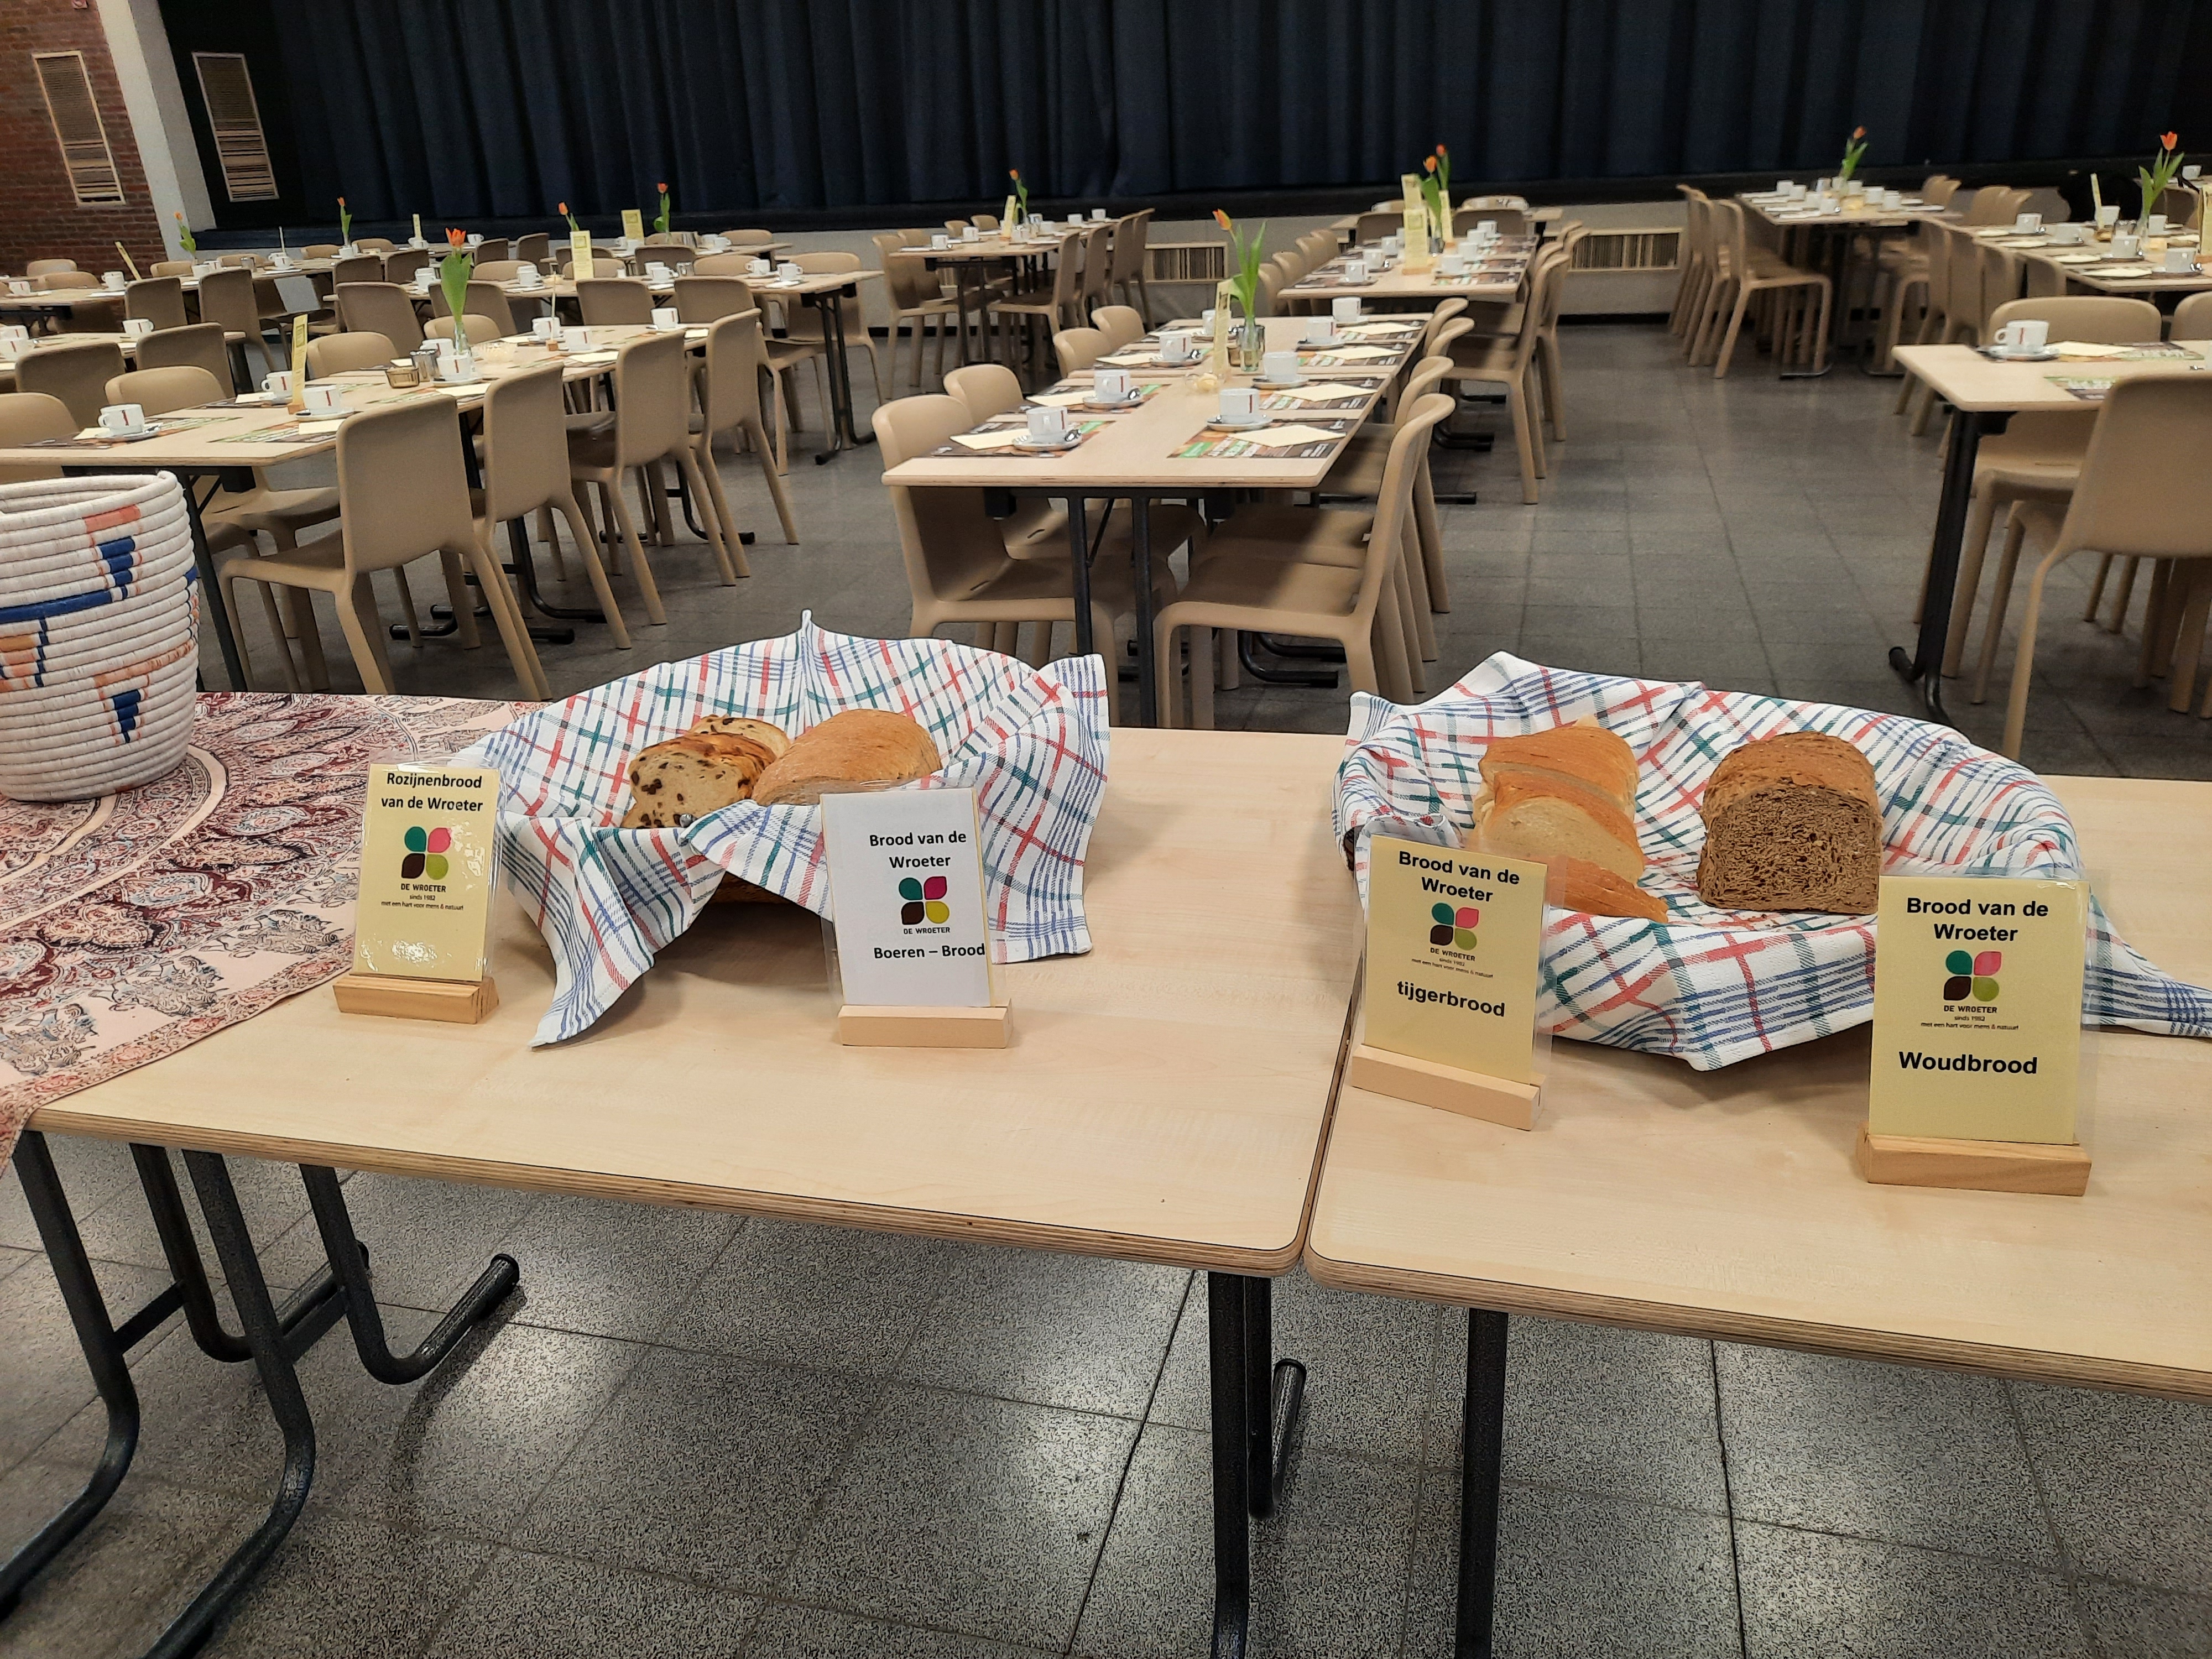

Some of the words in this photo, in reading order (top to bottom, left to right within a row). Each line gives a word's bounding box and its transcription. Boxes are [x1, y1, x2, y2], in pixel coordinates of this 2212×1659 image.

[387, 773, 482, 789] Rozijnenbrood
[381, 797, 404, 808] van
[408, 796, 424, 809] de
[428, 797, 483, 811] Wroeter
[870, 832, 914, 846] Brood
[917, 833, 943, 844] van
[948, 831, 967, 843] de
[889, 856, 951, 868] Wroeter
[1399, 851, 1453, 874] Brood
[1458, 864, 1491, 880] van
[1497, 869, 1520, 885] de
[1421, 877, 1493, 902] Wroeter
[1907, 898, 1971, 915] Brood
[1978, 902, 2015, 916] van
[2022, 900, 2049, 917] de
[1934, 923, 2018, 941] Wroeter
[874, 947, 925, 959] Boeren
[942, 943, 985, 957] Brood
[1442, 950, 1475, 961] WROETER
[1397, 980, 1505, 1017] tijgerbrood
[1899, 1051, 2038, 1074] Woudbrood
